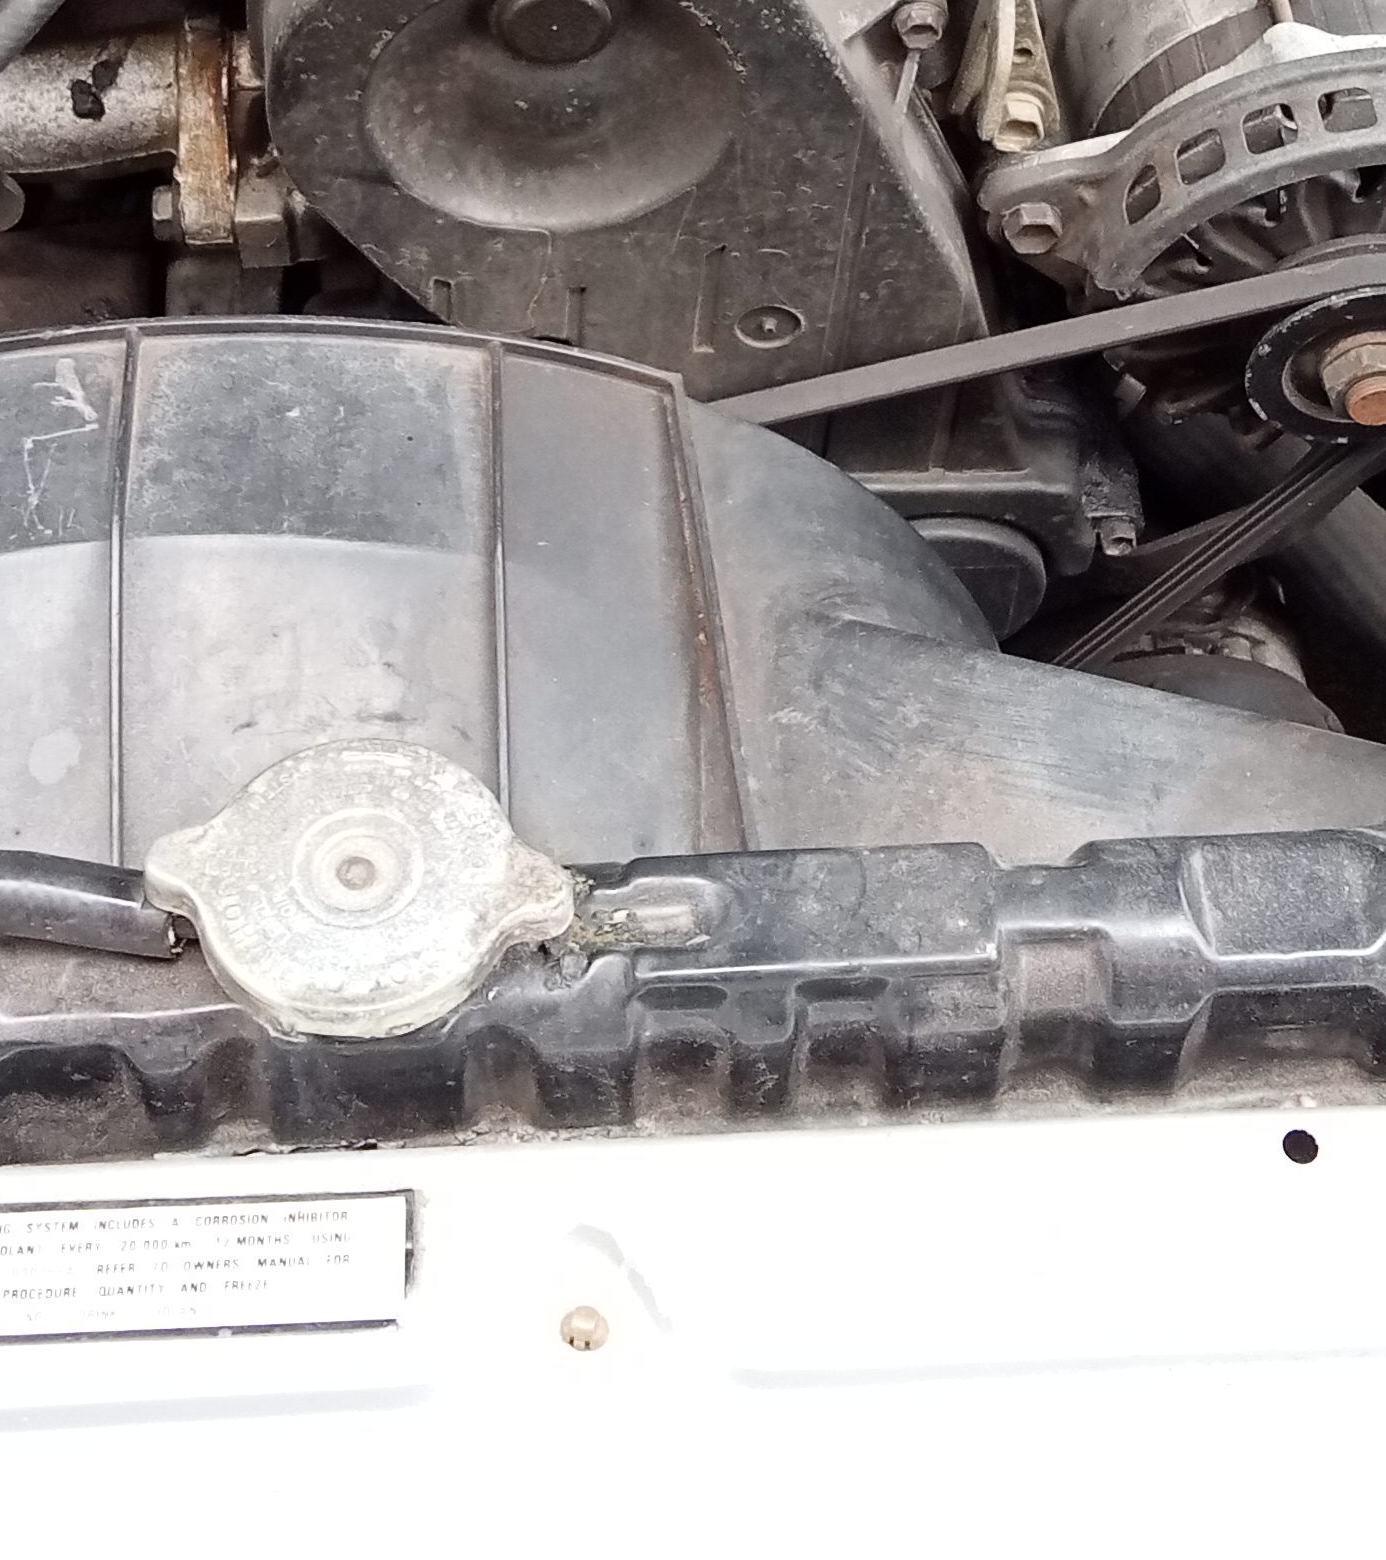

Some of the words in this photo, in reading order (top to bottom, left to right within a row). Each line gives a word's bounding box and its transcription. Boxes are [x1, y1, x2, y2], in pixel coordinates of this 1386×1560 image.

[26, 1221, 79, 1233] SYSTEM
[94, 1218, 155, 1230] INCLUDES
[171, 1217, 179, 1227] A
[195, 1214, 269, 1227] CORROSION
[283, 1210, 348, 1223] INHIBITOR
[236, 1234, 290, 1246] MONTHS
[183, 1258, 240, 1272] OWNERS
[3, 1287, 77, 1300] PROCEDURE
[180, 1282, 207, 1293] AND
